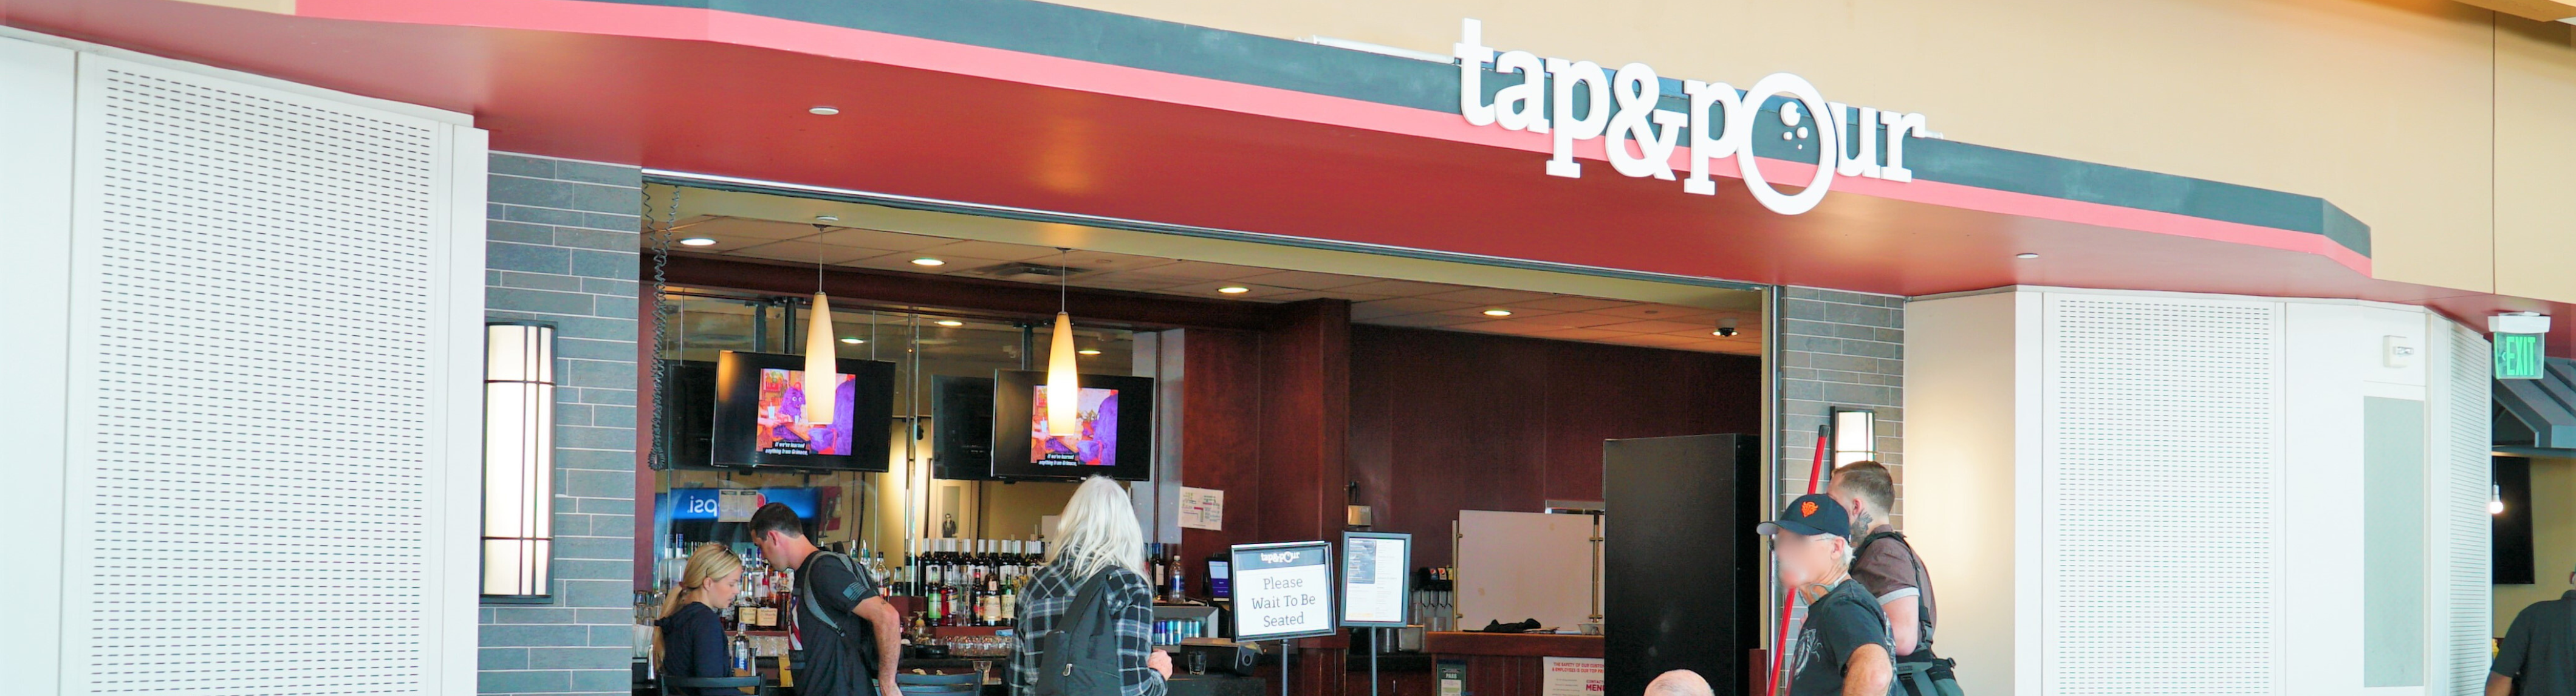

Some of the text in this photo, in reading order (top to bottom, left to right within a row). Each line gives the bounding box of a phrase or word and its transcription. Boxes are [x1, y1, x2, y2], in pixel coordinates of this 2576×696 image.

[2506, 336, 2536, 375] EXIT
[1263, 576, 1303, 590] Please
[1252, 594, 1315, 609] Wait To Be
[1263, 612, 1304, 627] Seated
